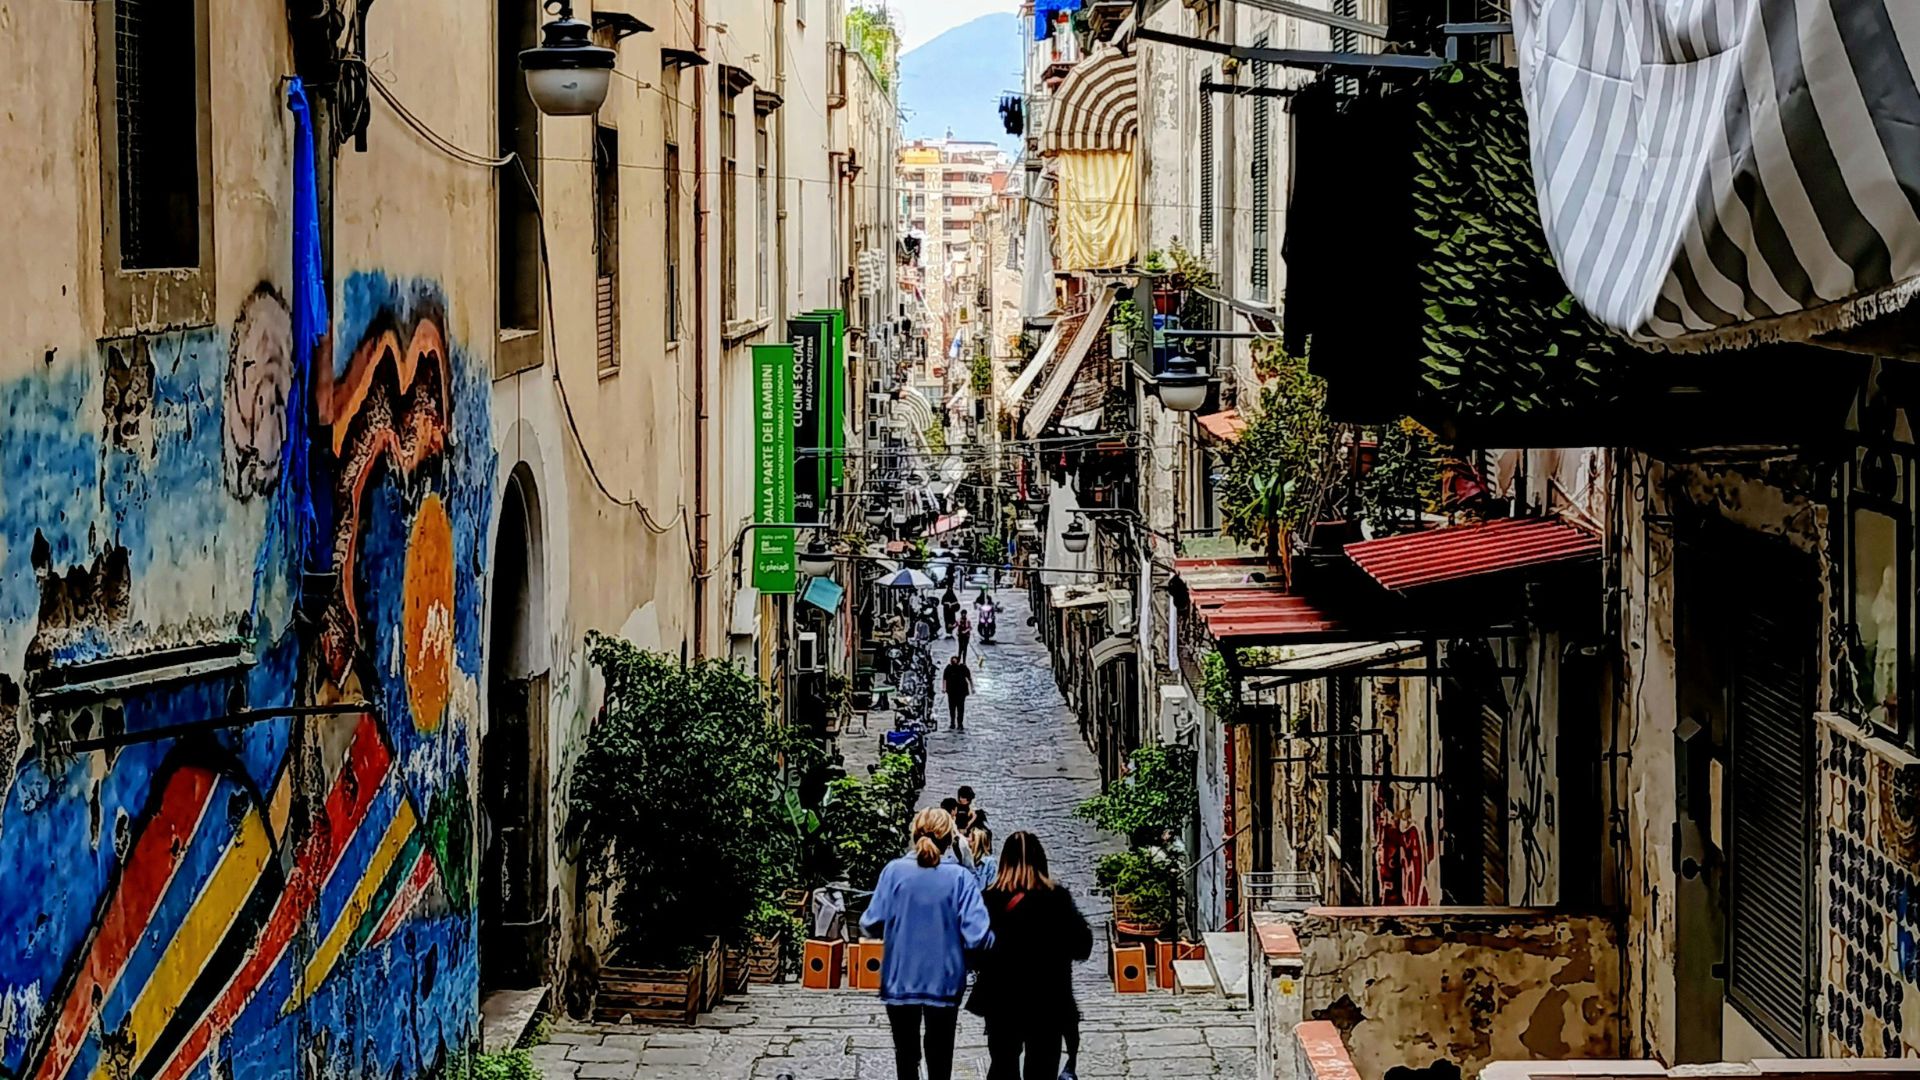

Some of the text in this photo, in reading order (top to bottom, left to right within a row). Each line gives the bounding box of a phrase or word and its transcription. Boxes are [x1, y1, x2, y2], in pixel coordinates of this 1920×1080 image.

[762, 364, 774, 524] DALLA PARTE DEI BAMBINI
[793, 335, 804, 427] CUCINE SOCIALI
